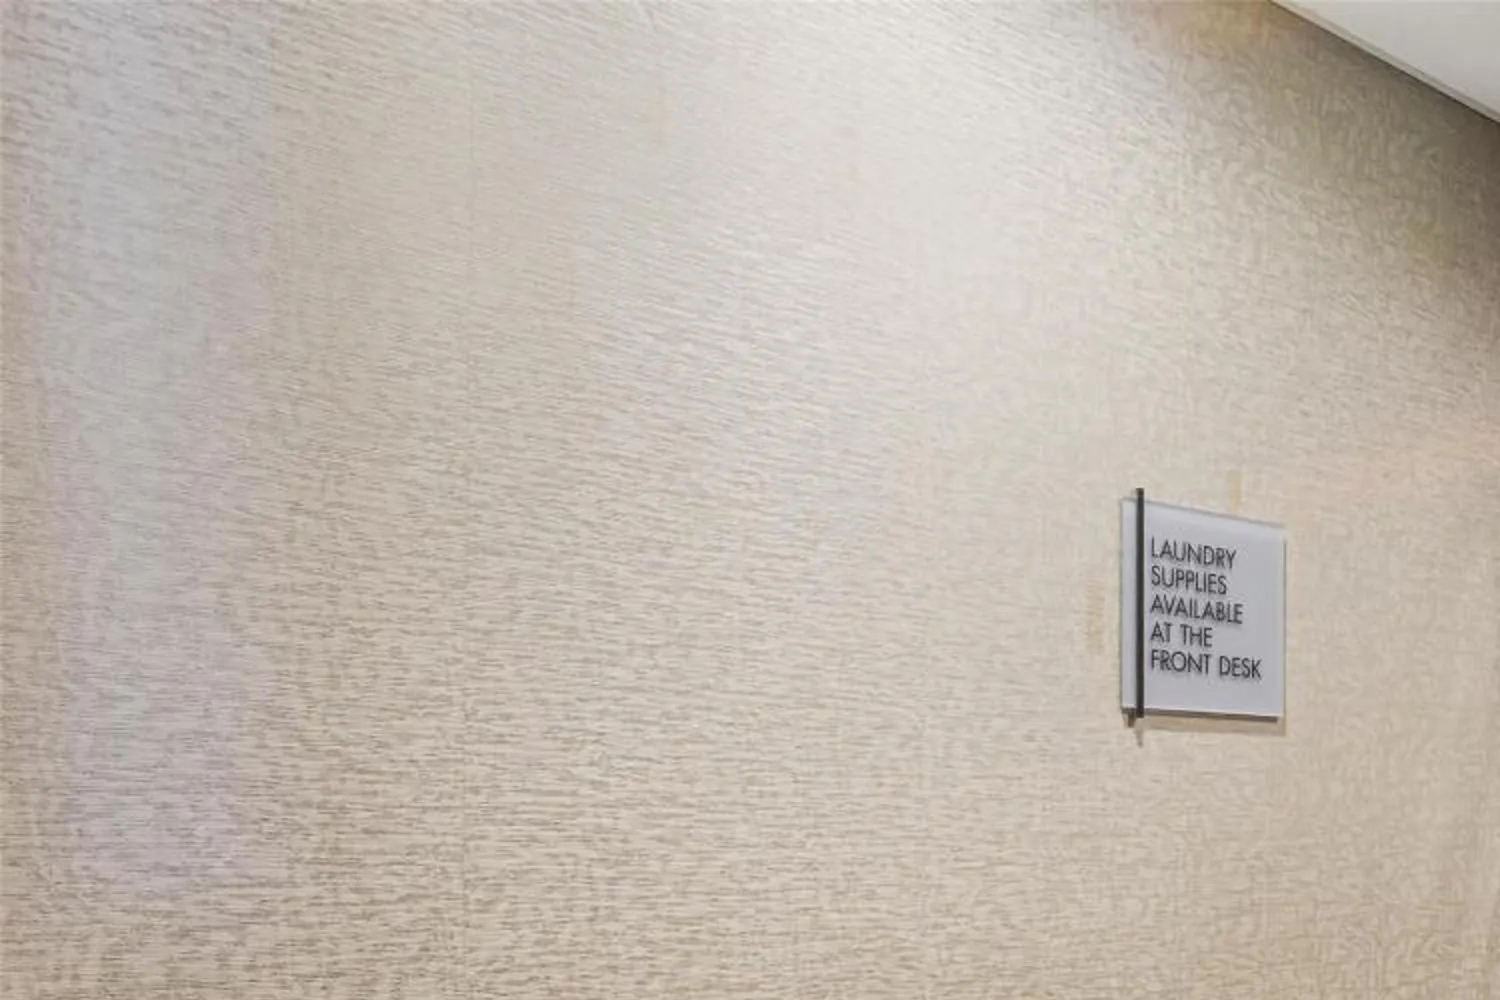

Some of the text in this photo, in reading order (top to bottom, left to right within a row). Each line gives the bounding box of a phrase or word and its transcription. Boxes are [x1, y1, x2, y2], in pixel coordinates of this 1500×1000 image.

[1151, 537, 1237, 569] LAUNDRY
[1151, 565, 1227, 595] SUPPLIES
[1150, 594, 1244, 625] AVAILABLE
[1150, 621, 1213, 648] AT THE
[1151, 650, 1262, 680] FRONT DESK
